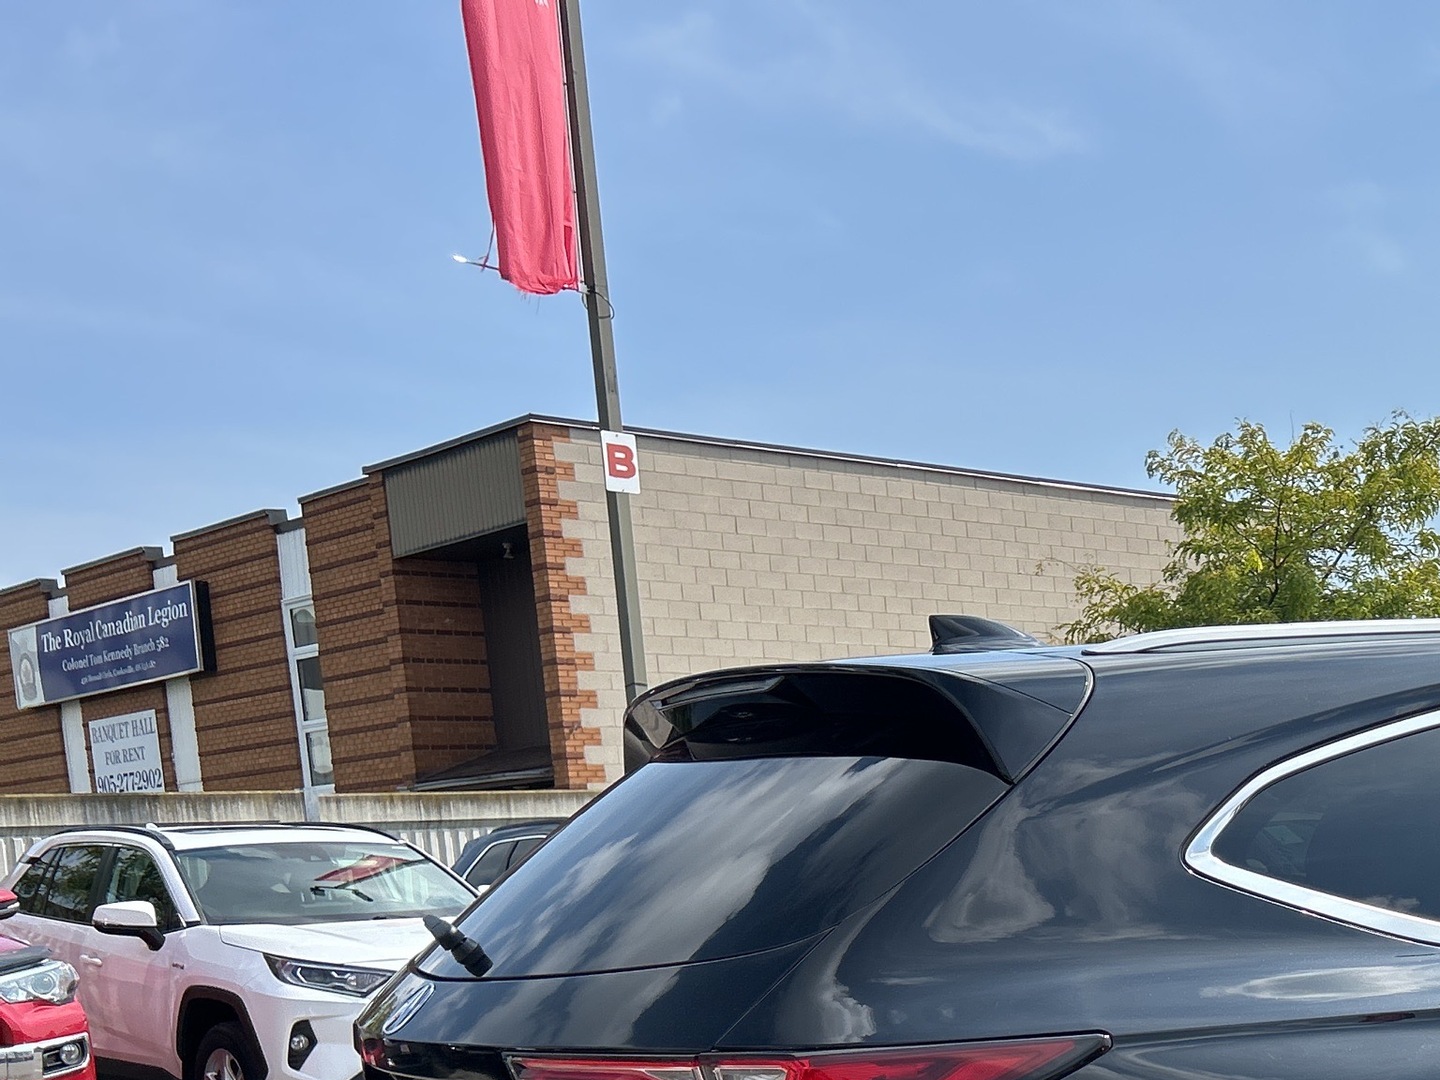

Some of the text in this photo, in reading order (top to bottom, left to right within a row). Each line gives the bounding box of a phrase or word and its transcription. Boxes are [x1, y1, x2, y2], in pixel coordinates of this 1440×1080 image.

[606, 442, 636, 479] B
[41, 600, 188, 653] The Royal Canadian Legion
[62, 635, 170, 672] Colonel Tom Kennedy Branch 582
[91, 717, 156, 743] BANQUET HALL
[104, 746, 145, 766] FOR RENT
